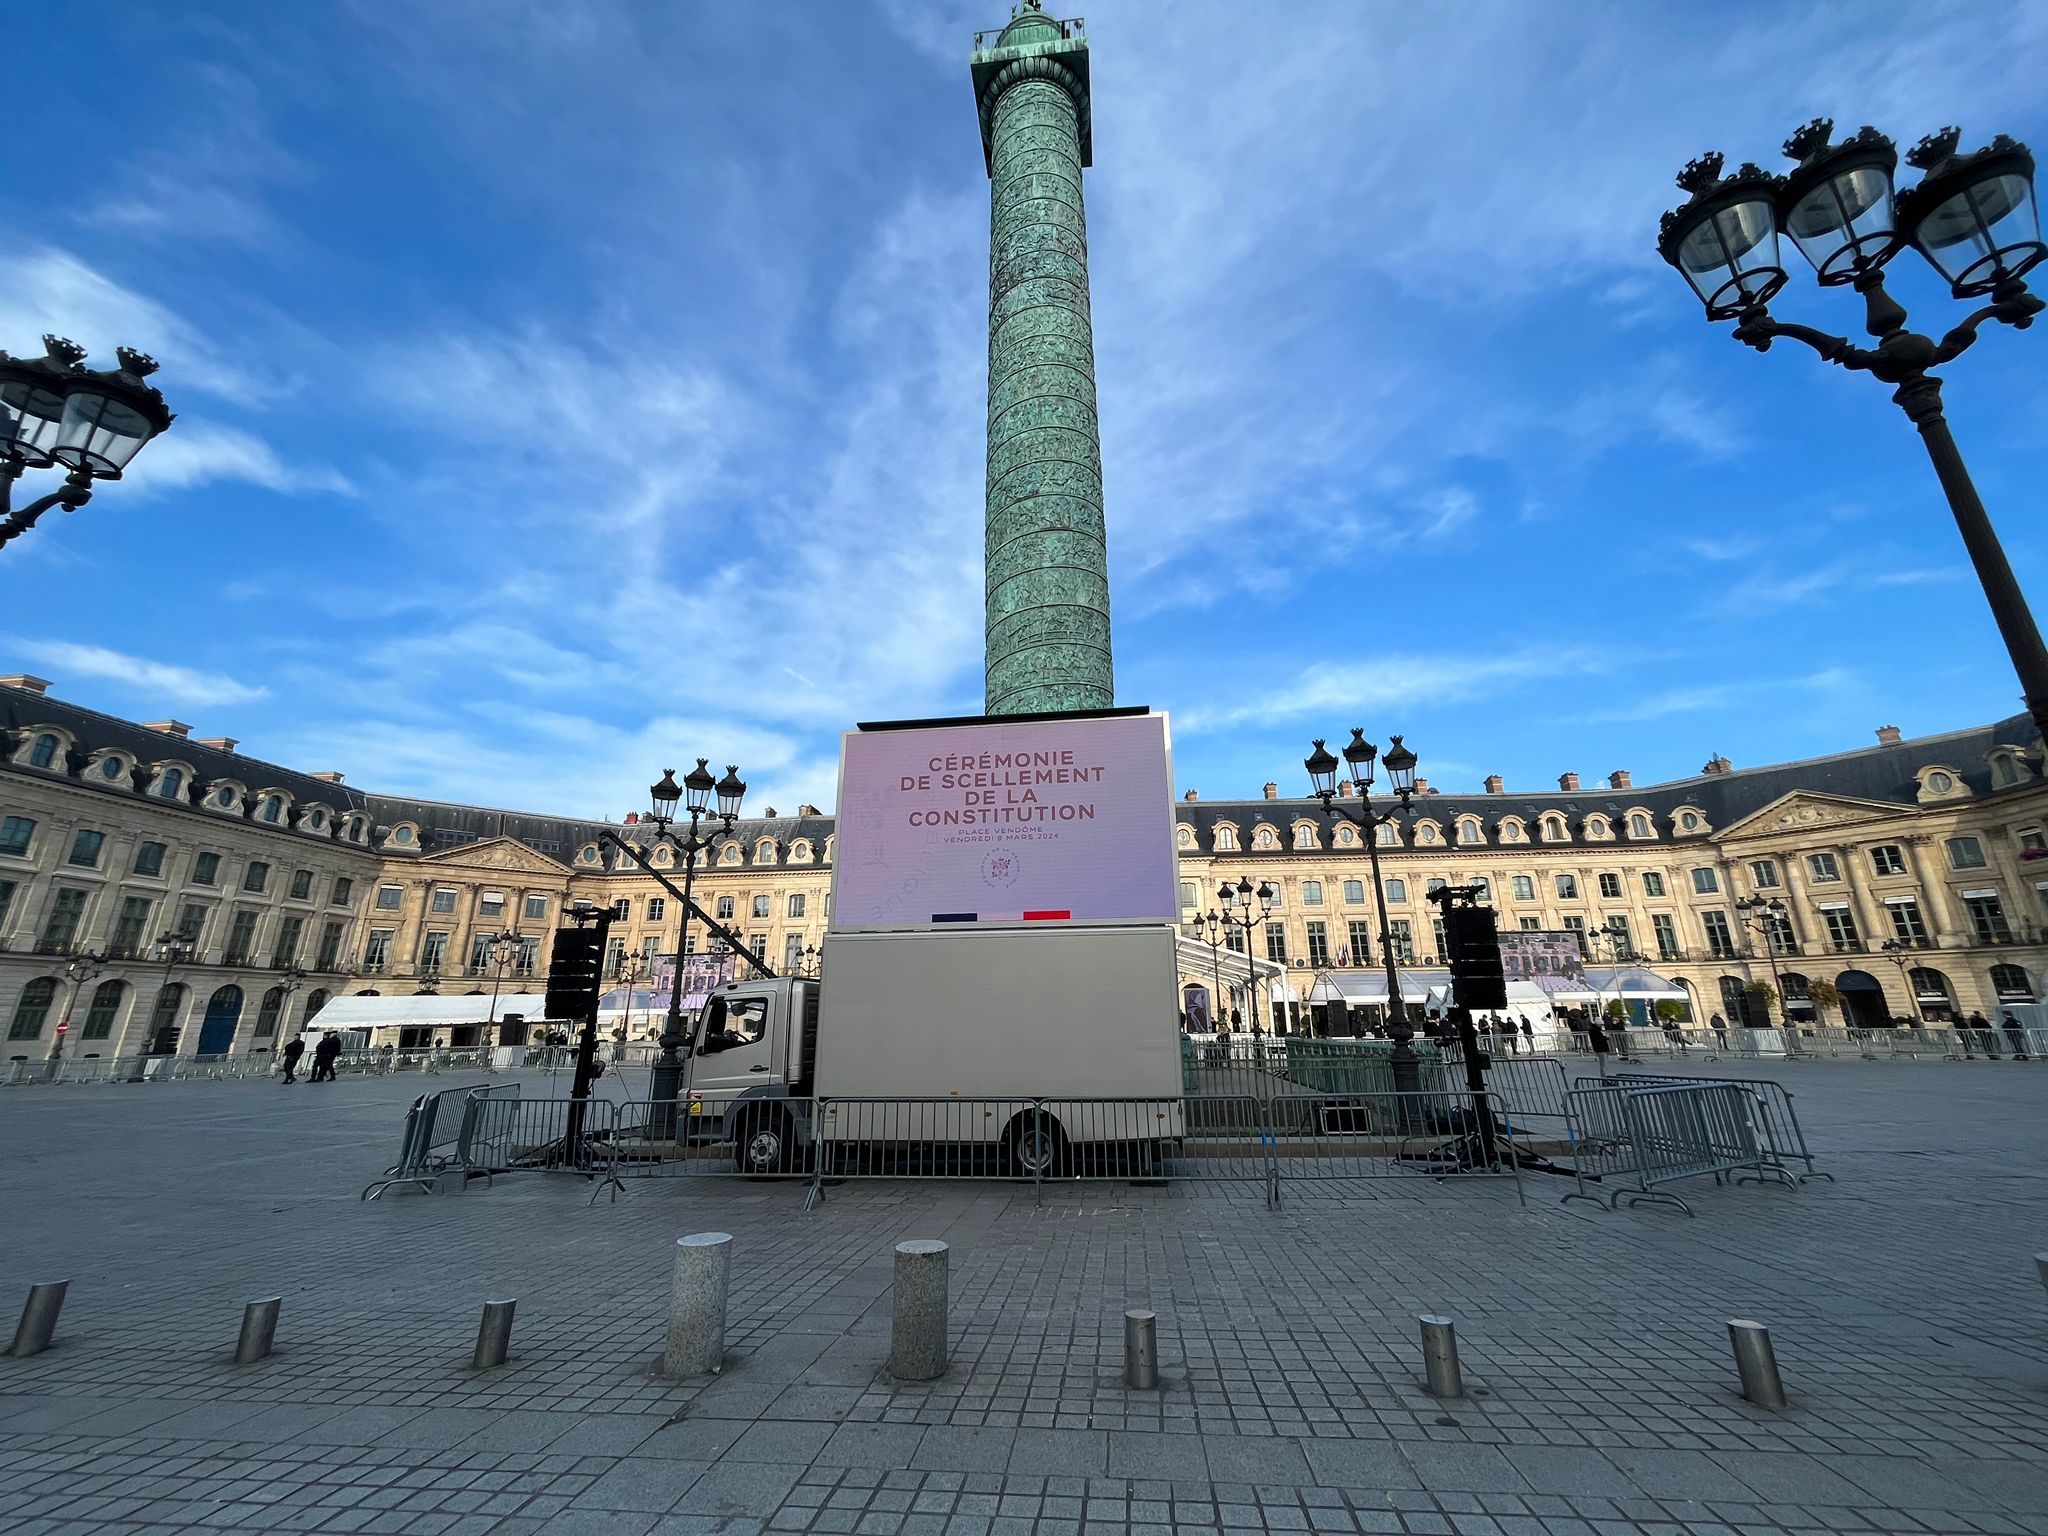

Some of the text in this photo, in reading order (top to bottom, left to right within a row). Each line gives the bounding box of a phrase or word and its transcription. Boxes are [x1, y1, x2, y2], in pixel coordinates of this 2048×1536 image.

[928, 750, 1074, 772] CÉRÉMONIE
[900, 766, 1105, 791] DE SCELLEMENT
[965, 788, 1038, 806] DE LA
[908, 803, 1095, 827] CONSTITUTION
[943, 835, 994, 843] VENDREDI
[1006, 833, 1034, 841] MARS
[1037, 832, 1059, 840] 2024
[958, 825, 1043, 836] PLACE VENDÔME
